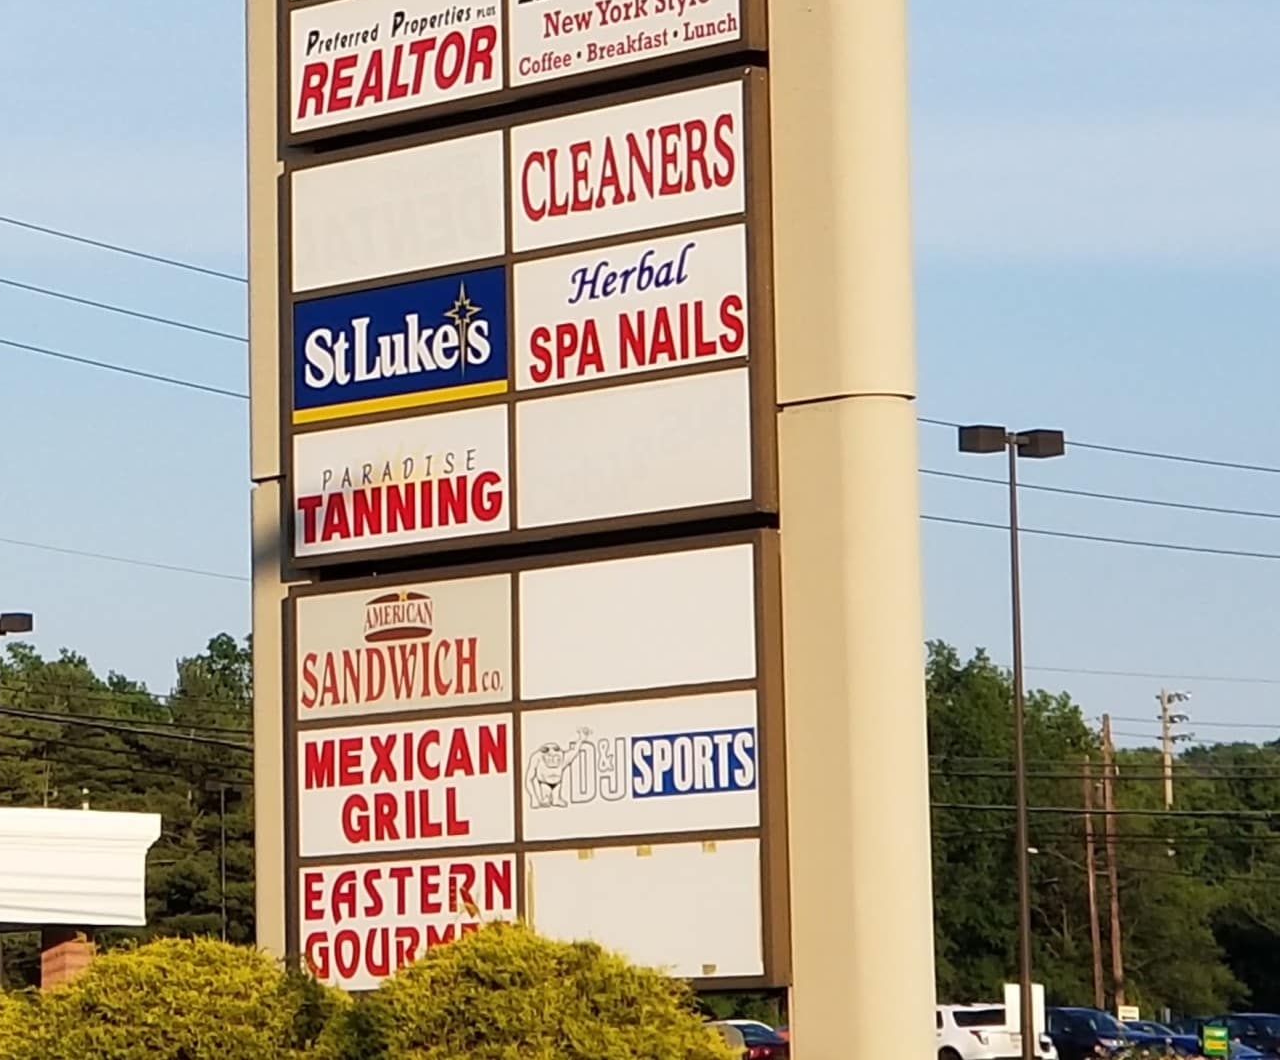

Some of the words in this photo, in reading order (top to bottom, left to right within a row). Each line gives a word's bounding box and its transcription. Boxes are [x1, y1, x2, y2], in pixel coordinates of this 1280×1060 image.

[306, 23, 380, 56] Preferred
[391, 6, 472, 38] Properties
[518, 51, 572, 76] Coffee
[586, 29, 669, 62] Breakfast
[683, 13, 738, 42] Lunch
[543, 10, 593, 39] New
[296, 24, 498, 120] REALTOR
[521, 113, 736, 222] CLEANERS
[567, 242, 696, 304] Herbal
[529, 318, 606, 383] SPA
[619, 294, 746, 370] NAILS
[322, 449, 477, 491] PARADISE
[297, 470, 503, 545] TANNING
[364, 600, 433, 631] AMERICAN
[301, 637, 478, 709] SANDWICH
[304, 723, 509, 790] MEXICAN
[569, 737, 627, 804] D&J
[632, 731, 756, 795] SPORTS
[341, 786, 471, 843] GRILL
[304, 859, 512, 925] EASTERN
